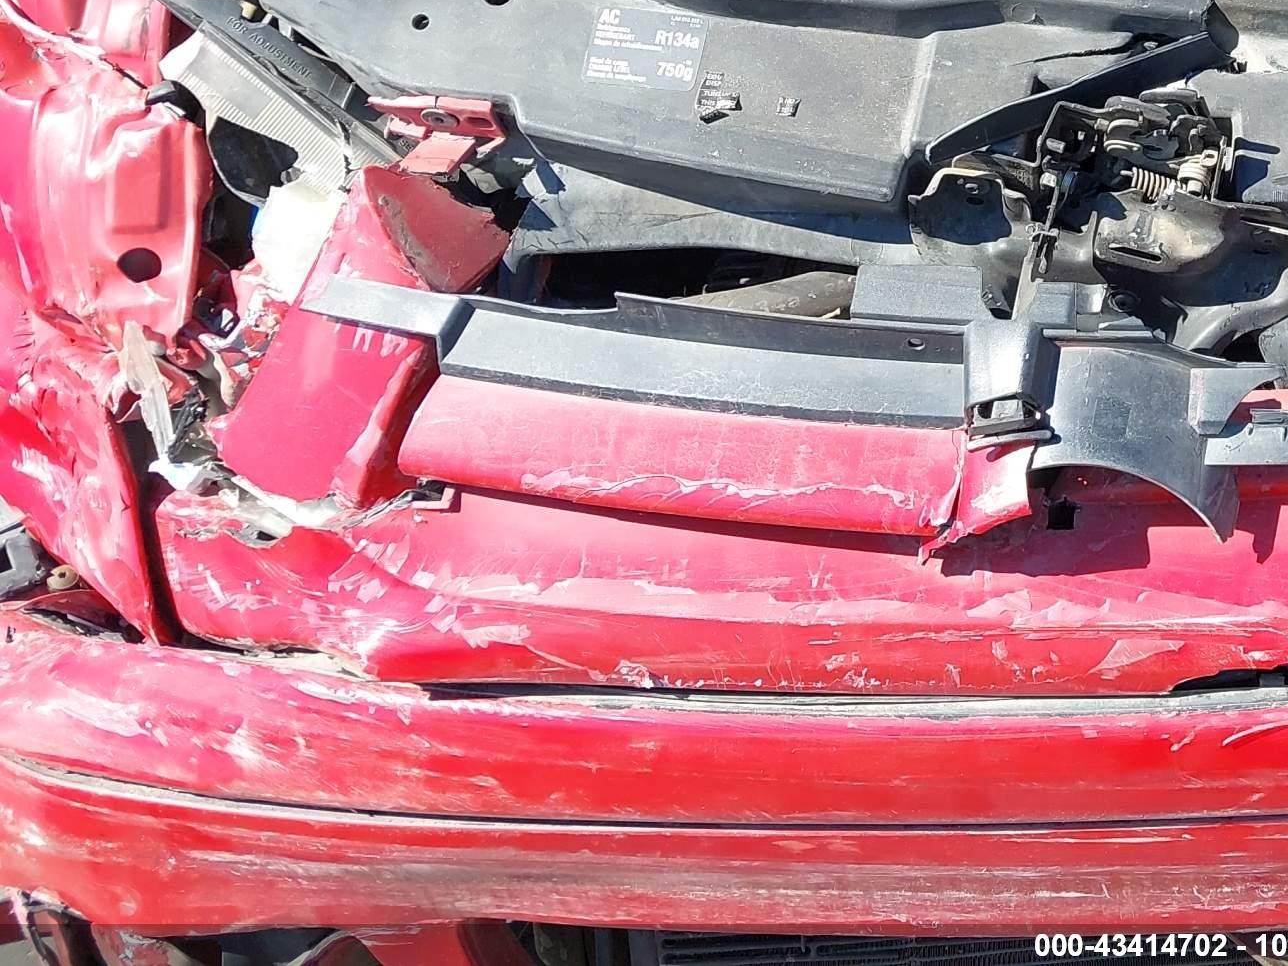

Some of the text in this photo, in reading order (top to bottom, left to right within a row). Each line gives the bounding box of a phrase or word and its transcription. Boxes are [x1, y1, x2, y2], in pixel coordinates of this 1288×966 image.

[224, 16, 249, 35] FOR
[598, 8, 621, 24] AC
[654, 29, 700, 49] R134a
[656, 60, 694, 82] 750g
